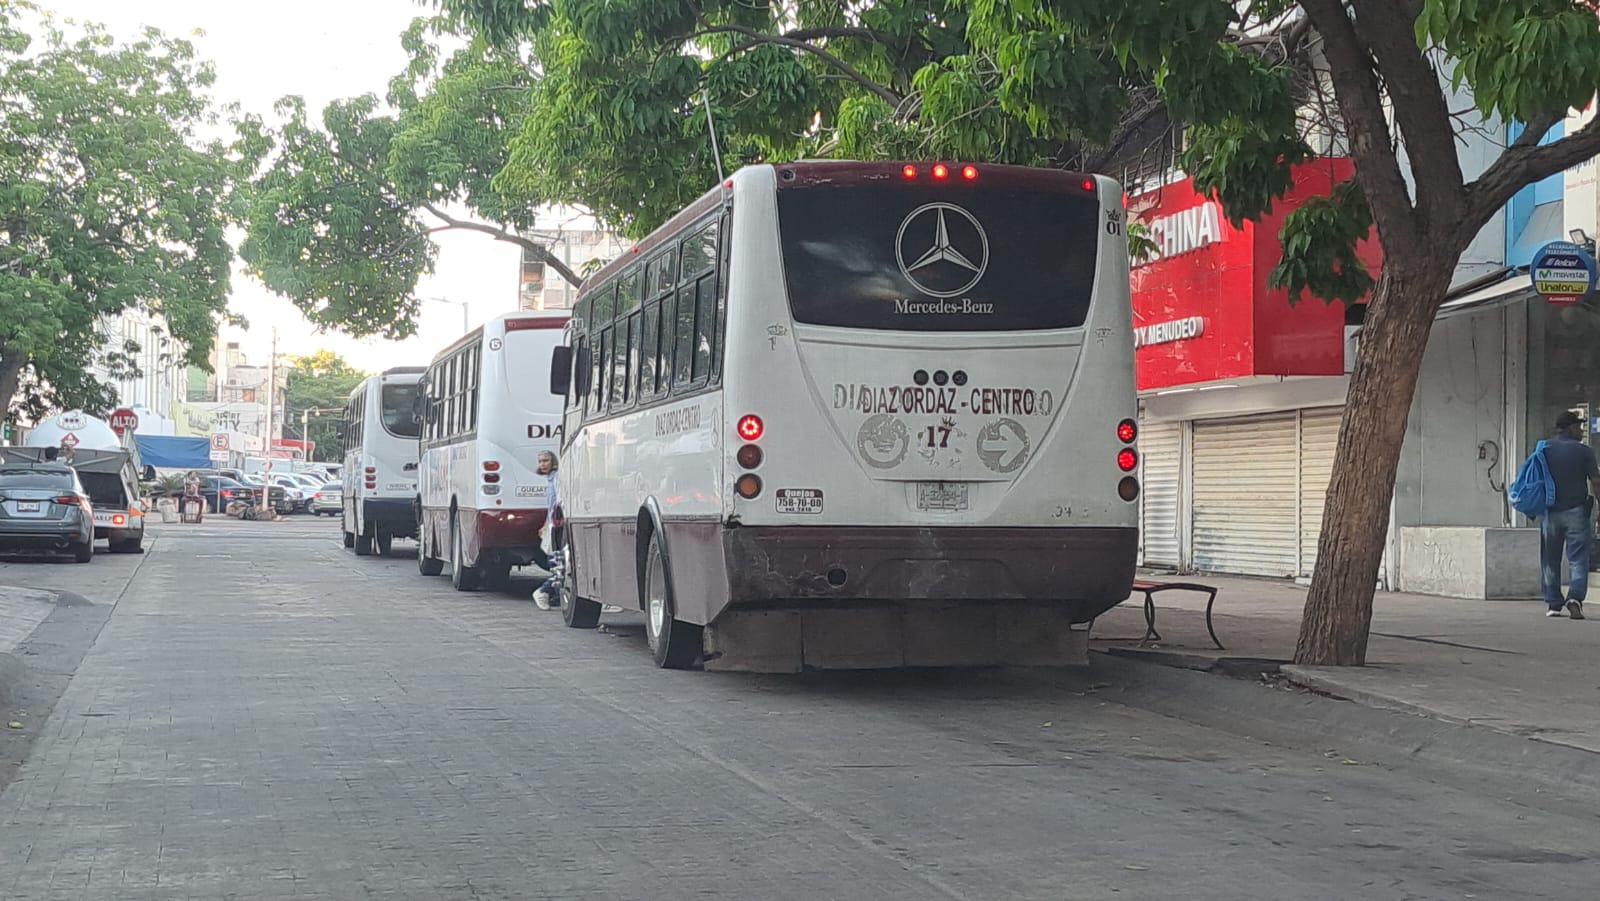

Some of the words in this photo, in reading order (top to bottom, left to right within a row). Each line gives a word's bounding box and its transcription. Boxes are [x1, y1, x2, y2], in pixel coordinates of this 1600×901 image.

[894, 298, 994, 314] Mercedes-Benz
[1148, 316, 1203, 346] MENUDEO
[862, 386, 899, 414] DIAZ
[902, 386, 957, 414] ORDAZ
[971, 387, 1034, 416] CENTRO
[113, 415, 137, 428] ALTO
[927, 425, 952, 448] 17
